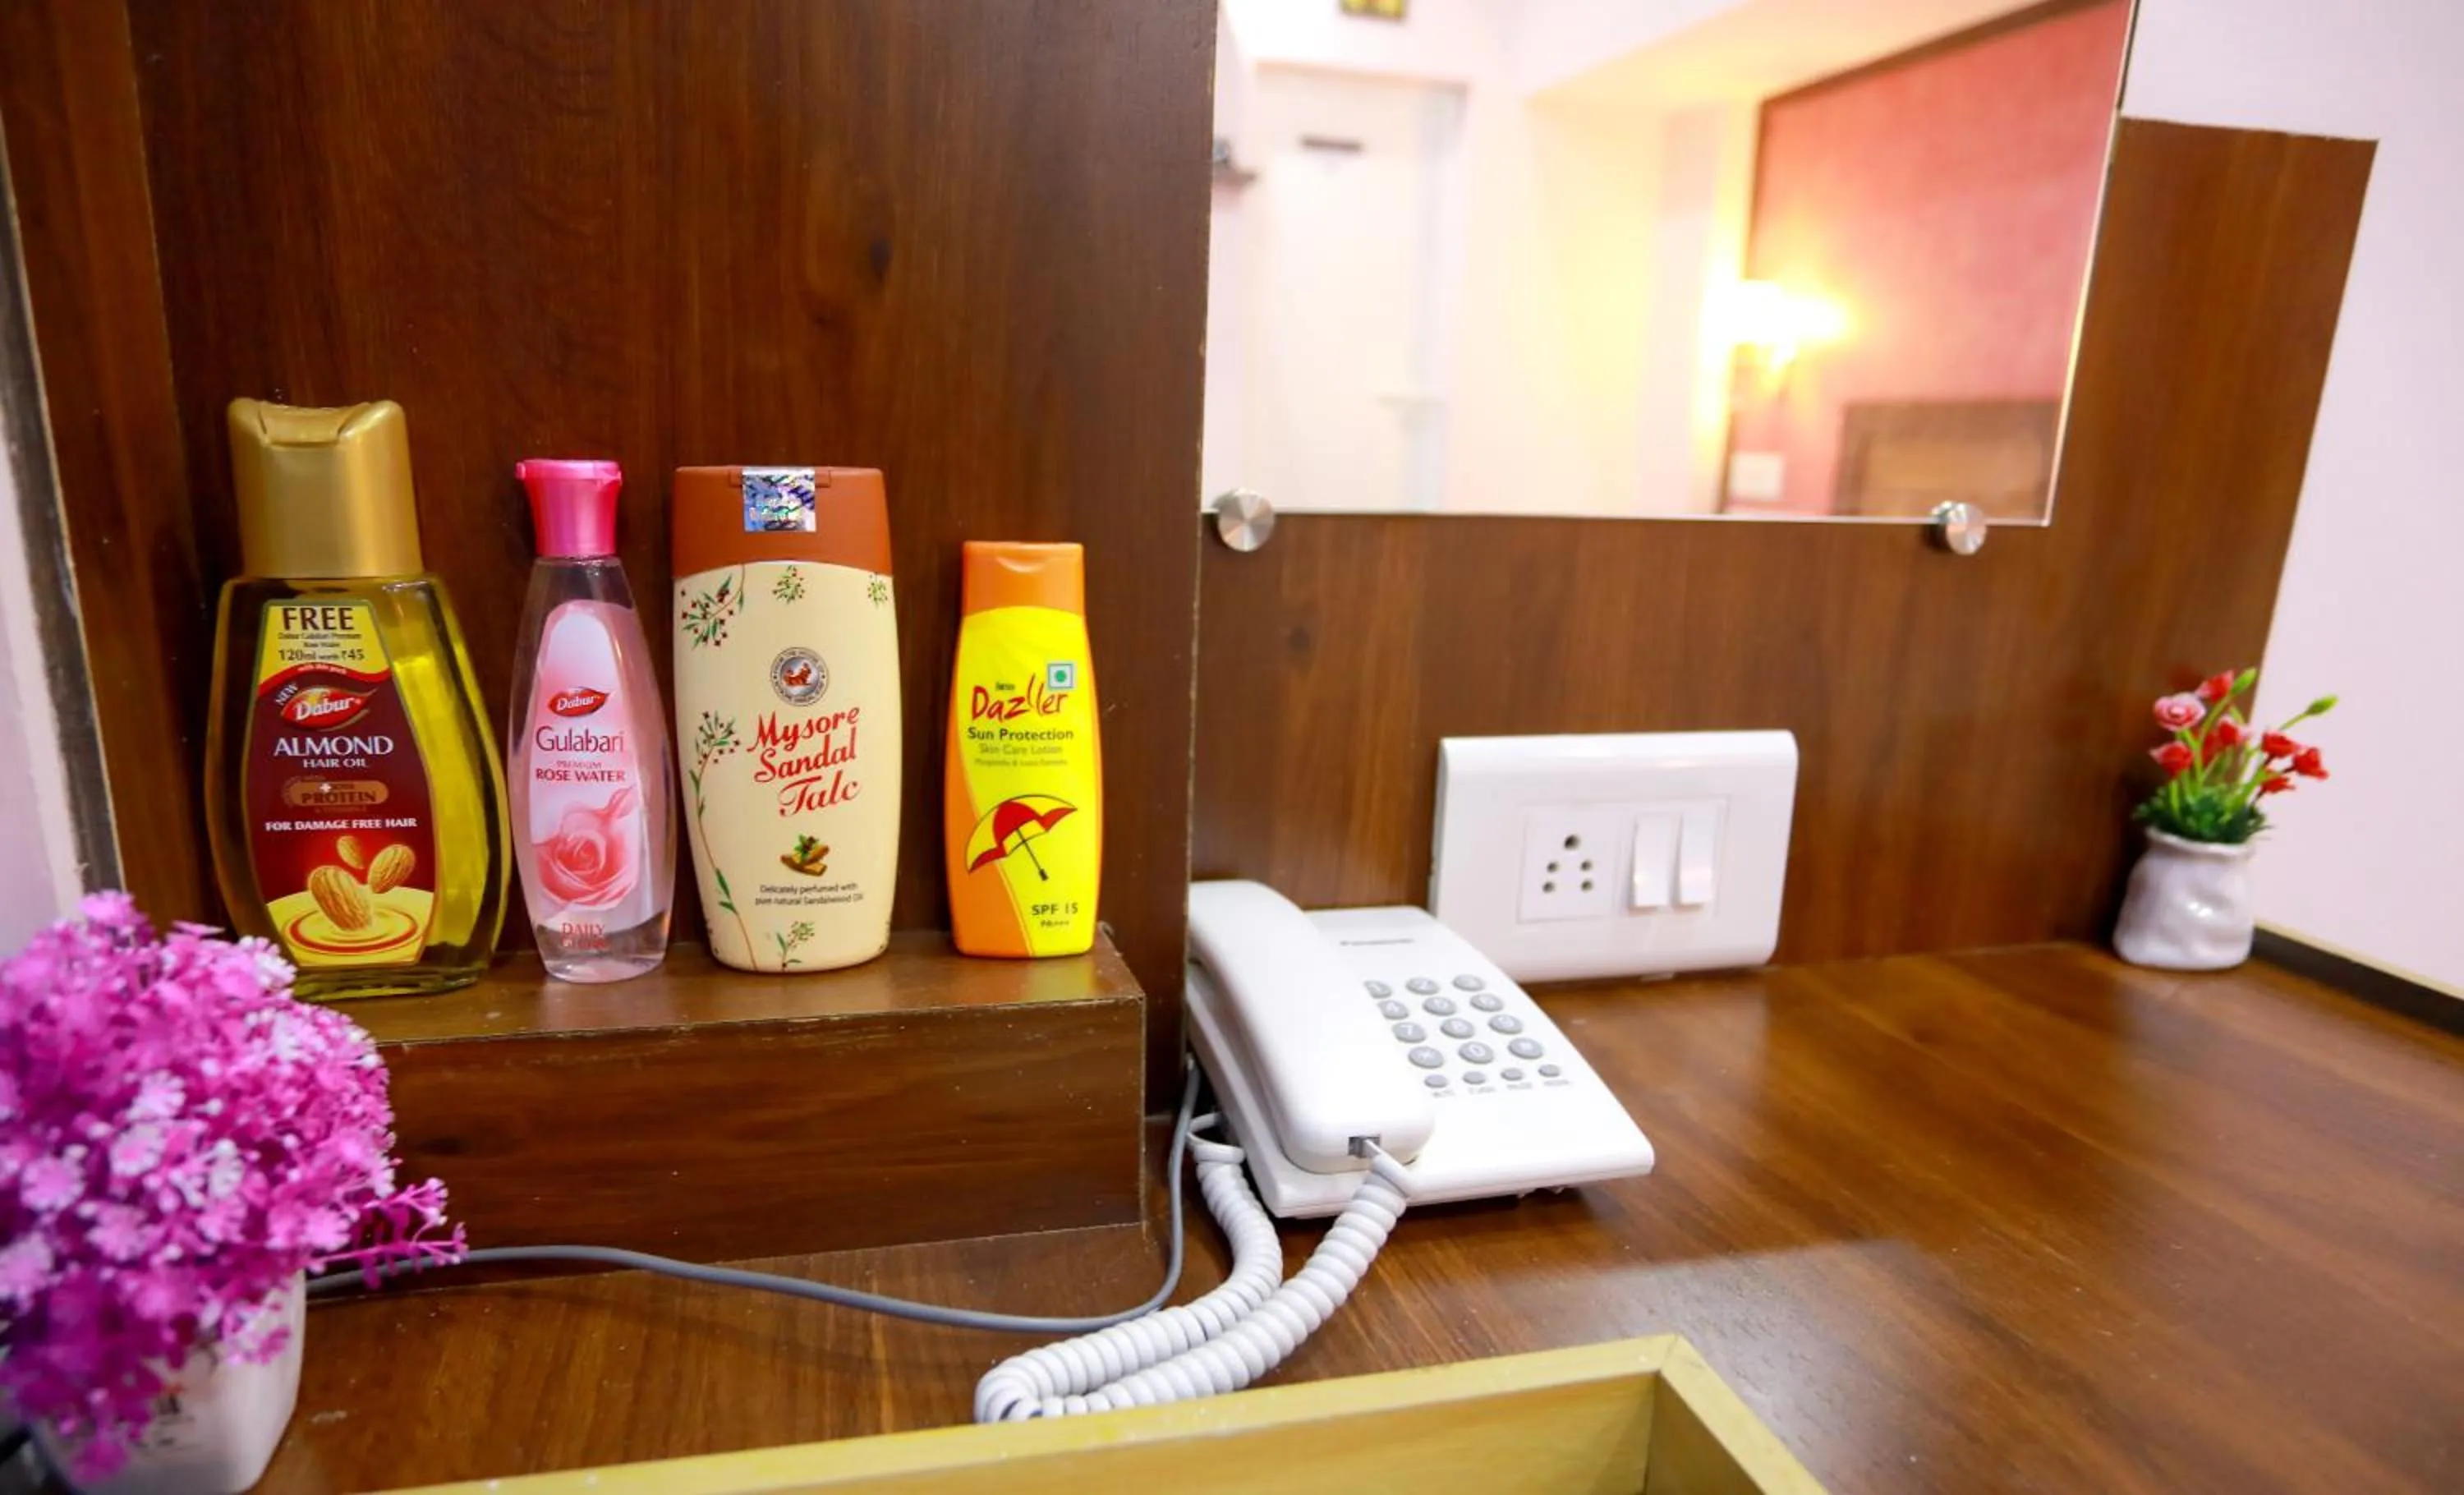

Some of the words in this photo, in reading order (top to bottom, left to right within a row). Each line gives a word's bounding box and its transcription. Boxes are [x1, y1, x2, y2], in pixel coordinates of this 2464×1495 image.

[283, 607, 354, 630] FREE
[278, 648, 316, 660] 120ml
[275, 683, 298, 706] NEW
[556, 695, 596, 711] Dabur
[972, 672, 1069, 723] Dazller
[296, 697, 354, 720] Dabur
[536, 725, 624, 753] Gulabari
[747, 706, 860, 752] Mysore
[968, 726, 995, 740] Sun
[1000, 728, 1074, 741] Protection
[274, 735, 394, 757] ALMOND
[753, 726, 857, 783] Sandal
[302, 758, 340, 768] HAIR
[342, 758, 368, 768] OIL
[536, 768, 572, 781] ROSE
[574, 770, 626, 782] WATER
[779, 769, 862, 817] Talc
[264, 821, 292, 831] FOR
[295, 819, 350, 830] DAMAGE
[352, 818, 381, 829] FREE
[386, 817, 417, 828] HAIR
[1031, 904, 1059, 916] SPF
[1064, 901, 1078, 914] 15
